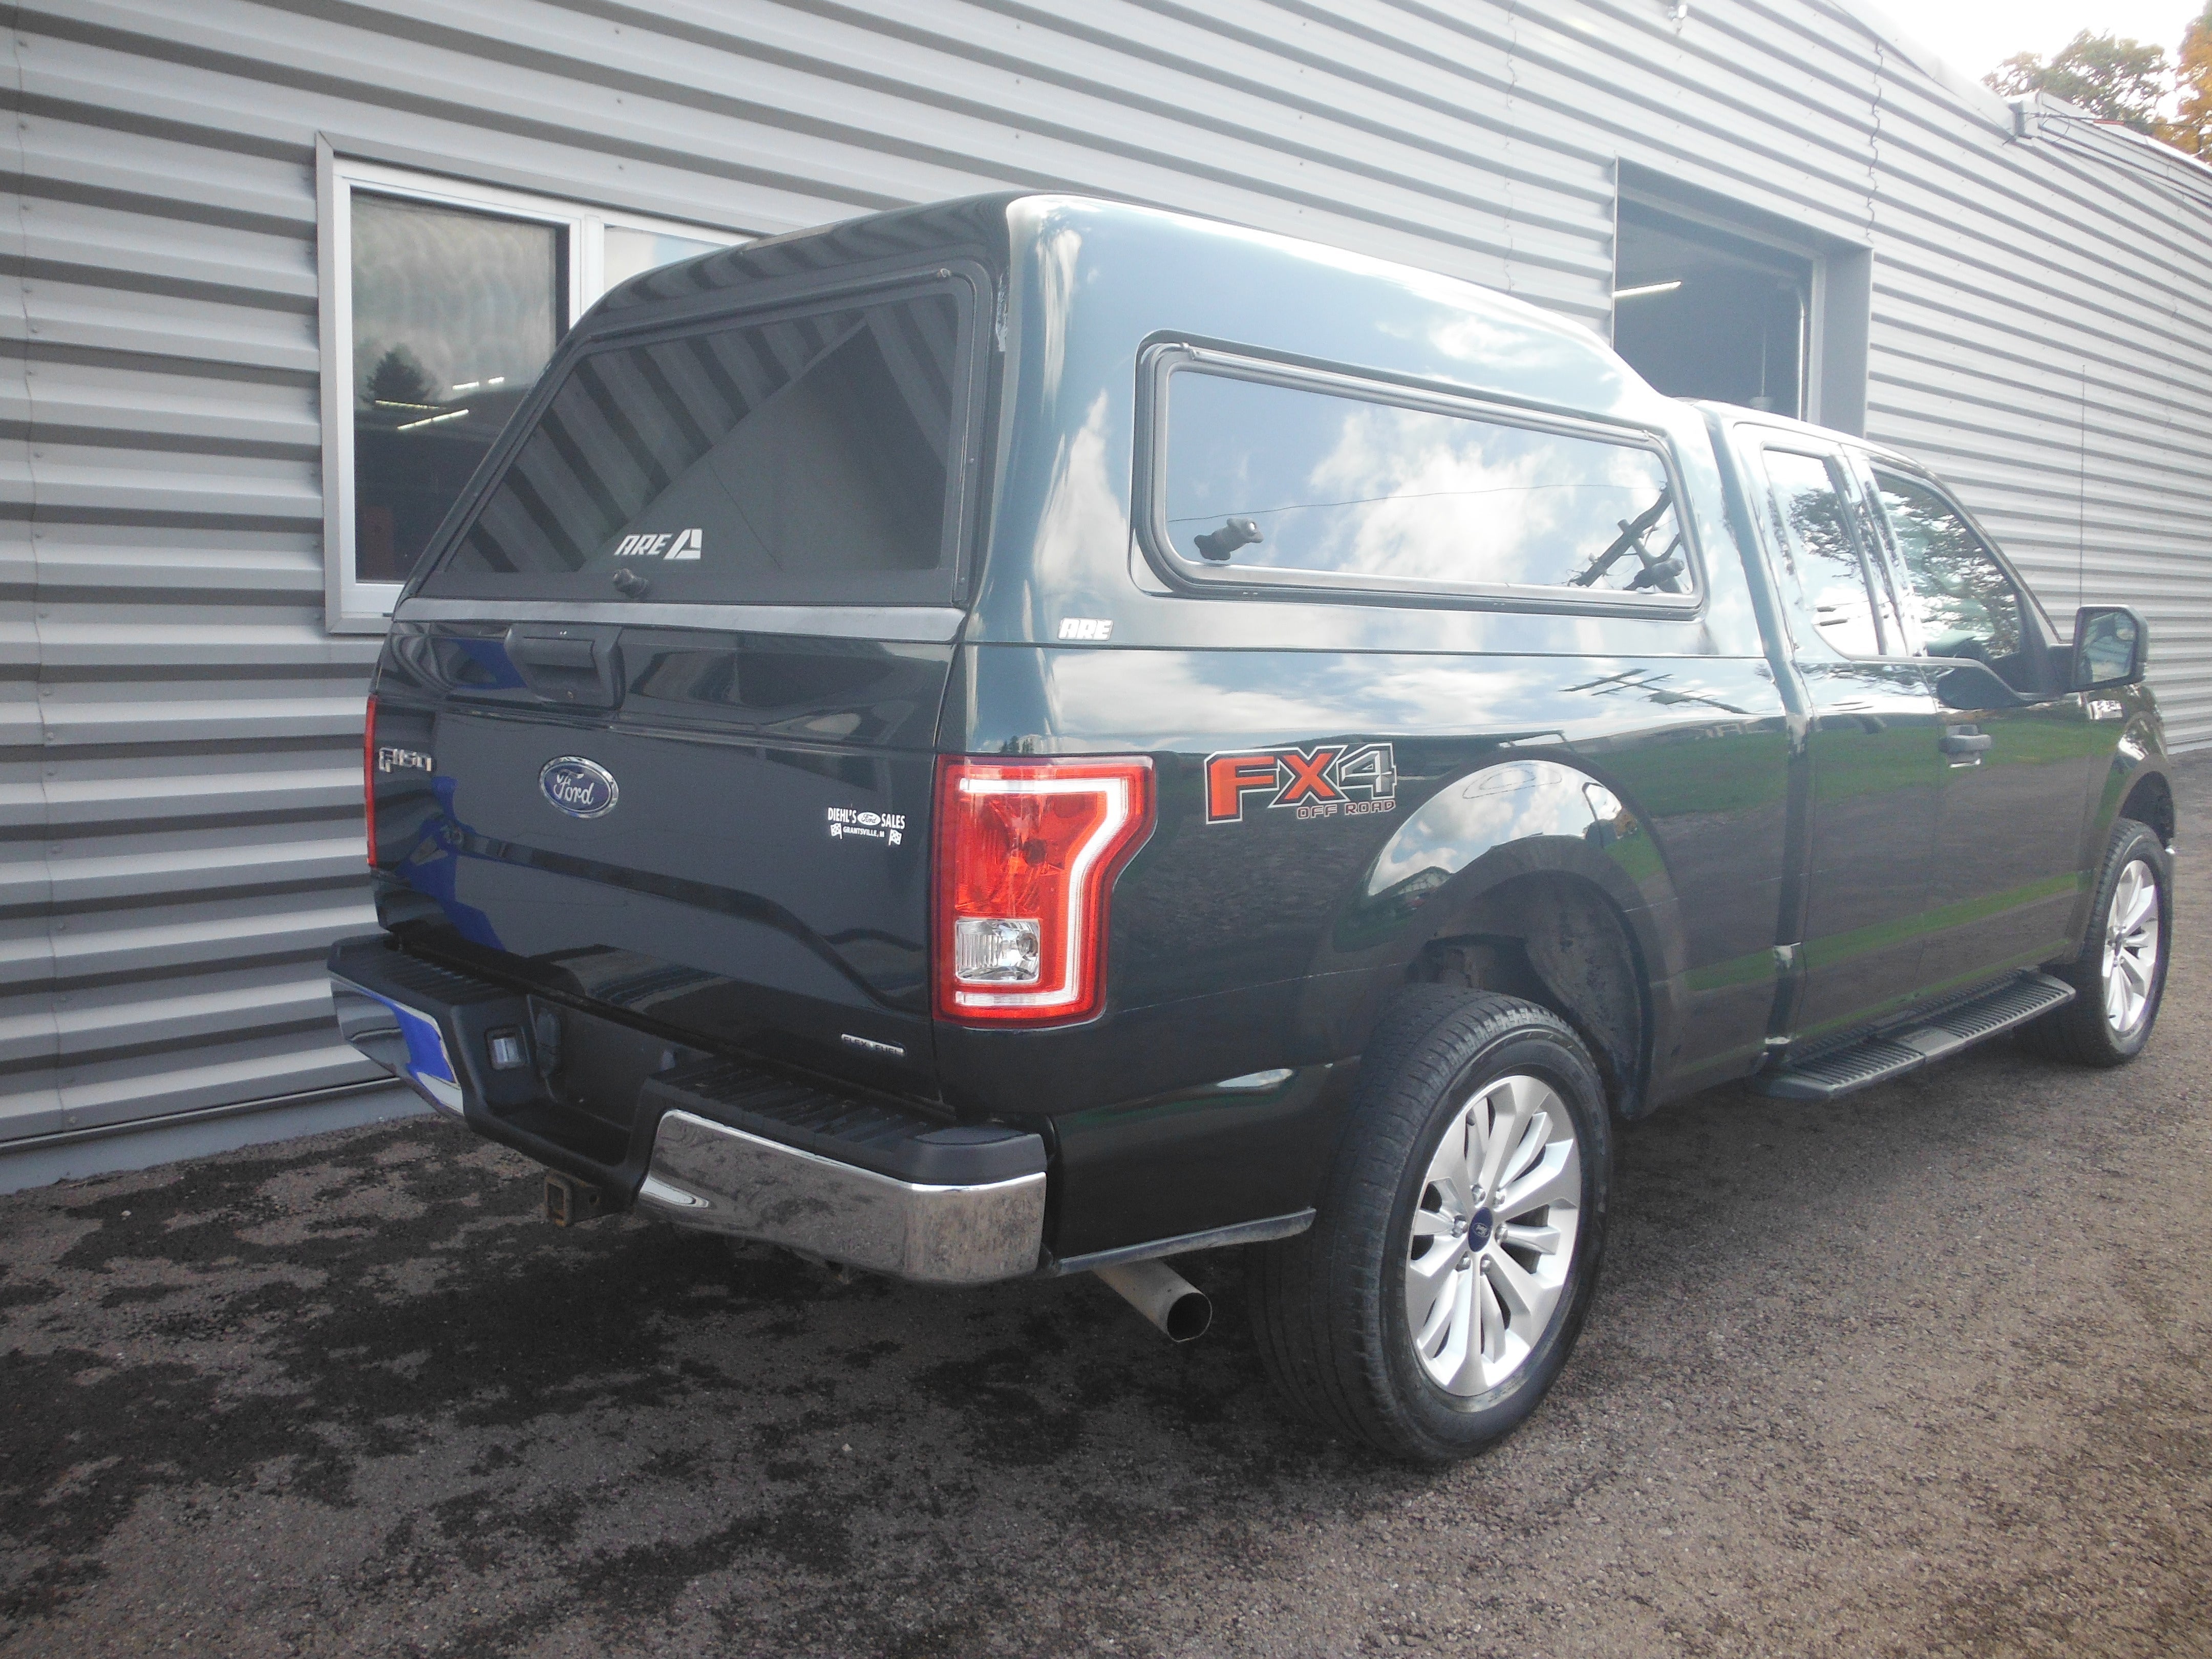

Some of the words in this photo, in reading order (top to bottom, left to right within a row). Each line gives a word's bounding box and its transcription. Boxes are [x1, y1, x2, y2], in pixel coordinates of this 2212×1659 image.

[613, 533, 673, 556] ARE
[1057, 618, 1114, 640] ARE
[554, 769, 595, 805] Ford
[1204, 741, 1397, 825] FX4
[827, 807, 857, 824] DIEHL'S
[881, 813, 906, 830] SALES
[1296, 804, 1337, 820] OFF
[1344, 799, 1396, 816] ROAD
[843, 826, 879, 838] GRANTSVILLE,
[843, 1036, 867, 1048] FLEX
